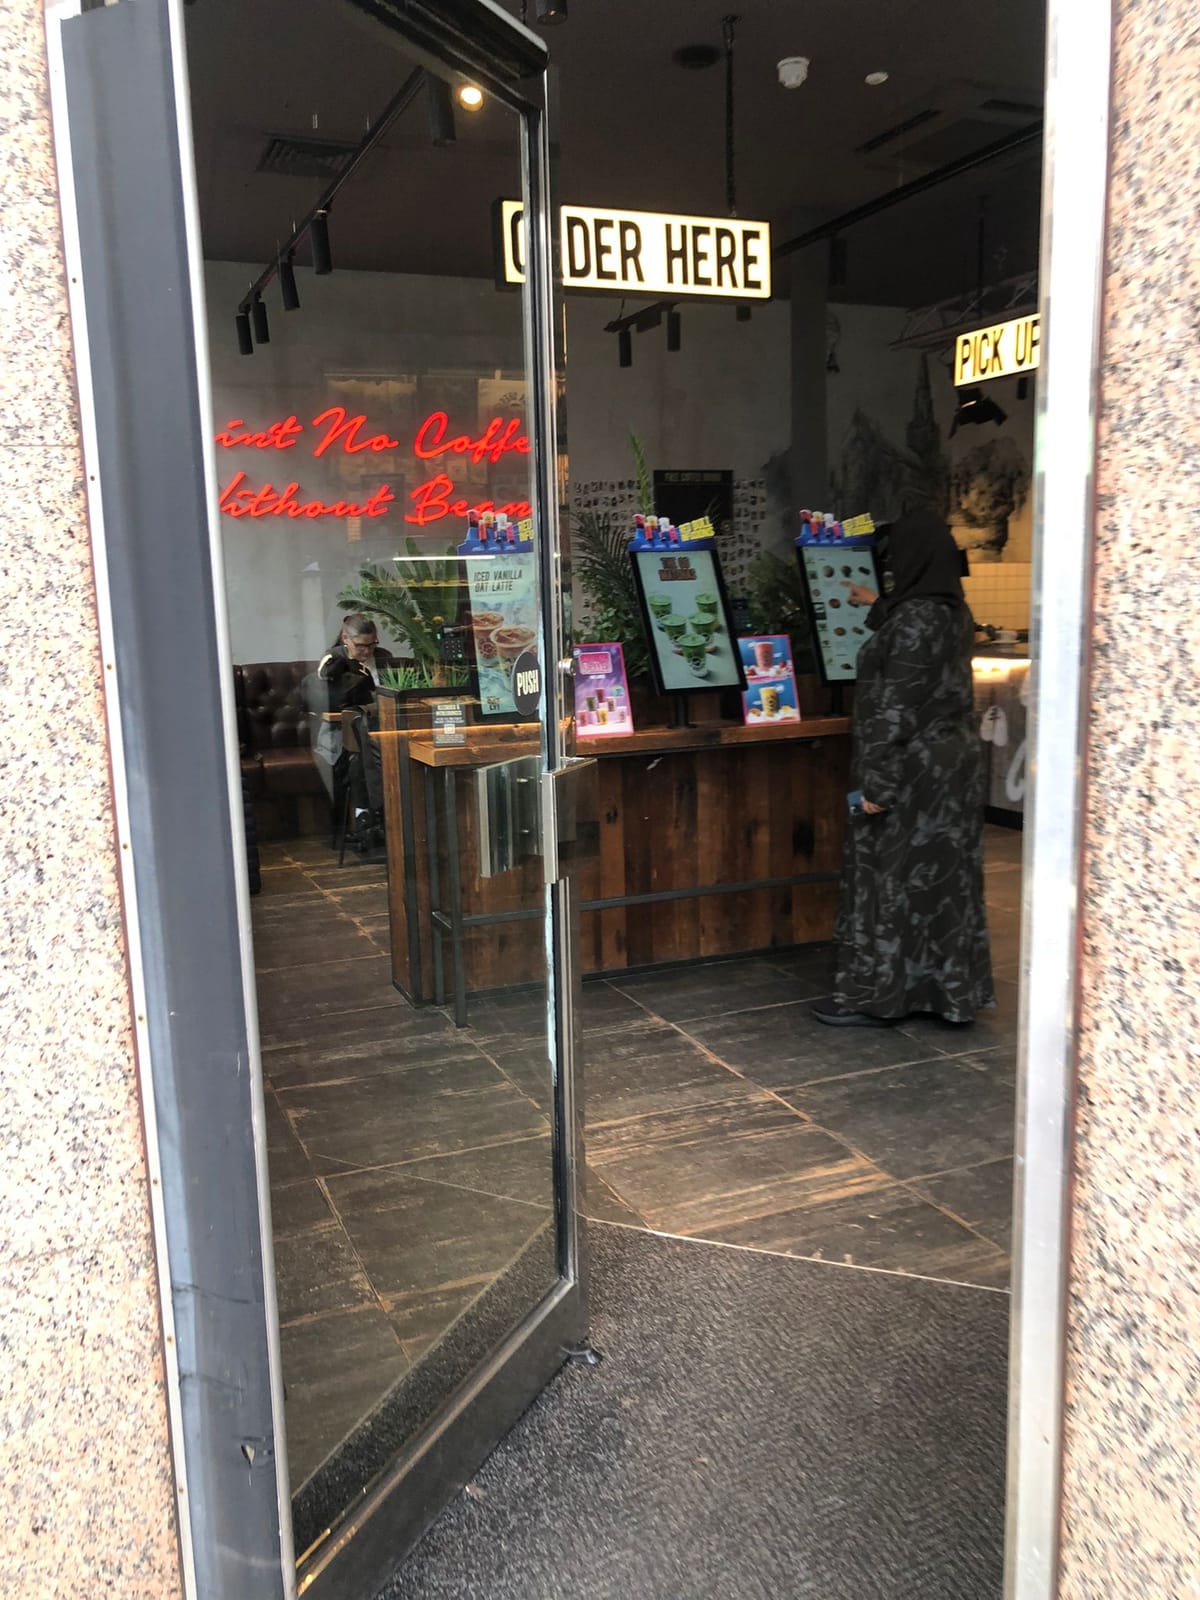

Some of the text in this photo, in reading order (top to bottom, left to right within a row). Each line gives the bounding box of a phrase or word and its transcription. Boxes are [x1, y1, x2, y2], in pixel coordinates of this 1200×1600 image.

[511, 210, 762, 290] ODER HERE
[960, 319, 1040, 380] PICK UP
[214, 406, 532, 464] int No Coffe
[404, 473, 534, 527] Bean
[474, 569, 523, 581] ICED VANILLA
[475, 581, 513, 592] OAT LATTE
[516, 669, 539, 697] PUSH
